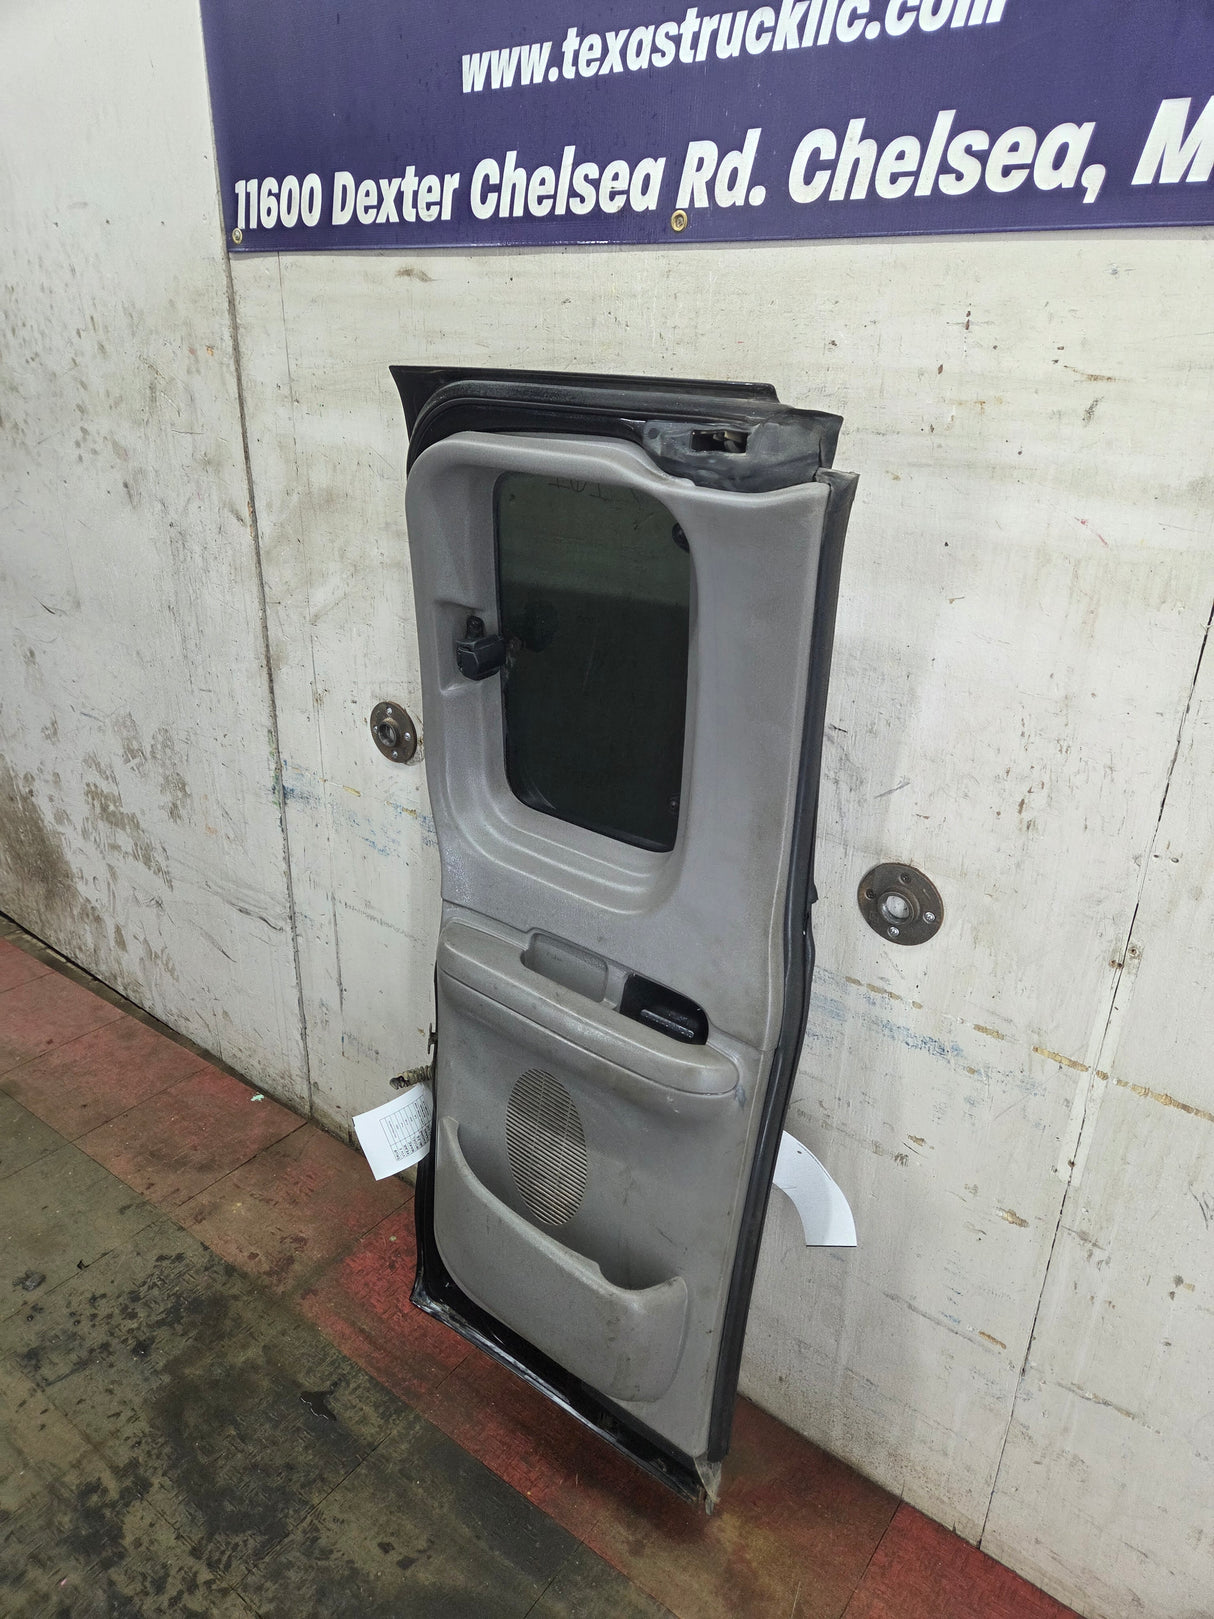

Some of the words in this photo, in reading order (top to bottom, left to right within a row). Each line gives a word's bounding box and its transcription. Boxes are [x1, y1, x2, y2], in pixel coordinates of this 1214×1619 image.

[234, 173, 322, 230] 11600
[331, 165, 460, 226] Dexter
[470, 145, 667, 220] Chelsea
[675, 127, 767, 209] Rd.
[788, 109, 1106, 204] Chelsea,
